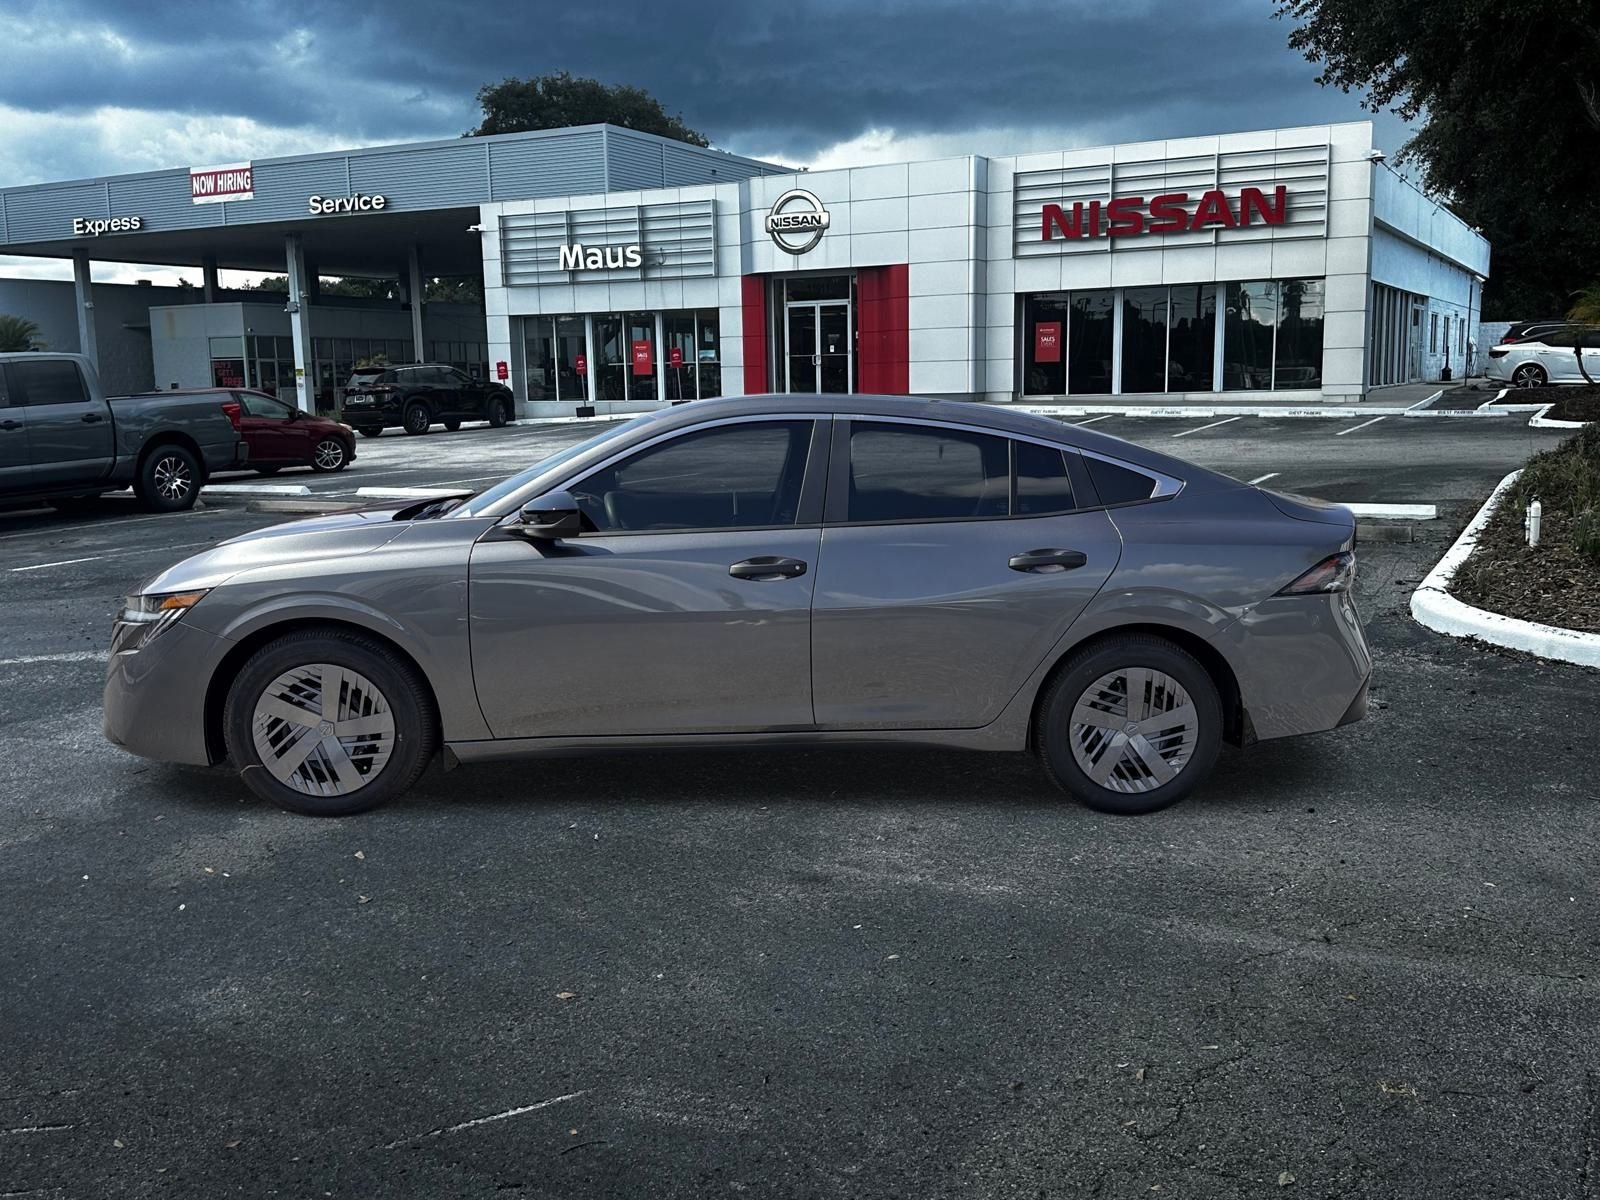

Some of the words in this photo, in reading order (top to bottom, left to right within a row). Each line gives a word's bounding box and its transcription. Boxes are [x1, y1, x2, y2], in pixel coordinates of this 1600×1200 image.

[192, 174, 215, 195] NOW
[217, 171, 251, 193] HIRING
[308, 193, 385, 214] Service
[1042, 184, 1287, 241] NISSAN
[73, 216, 141, 236] Express
[770, 214, 822, 228] NISSAN
[559, 243, 642, 271] Maus
